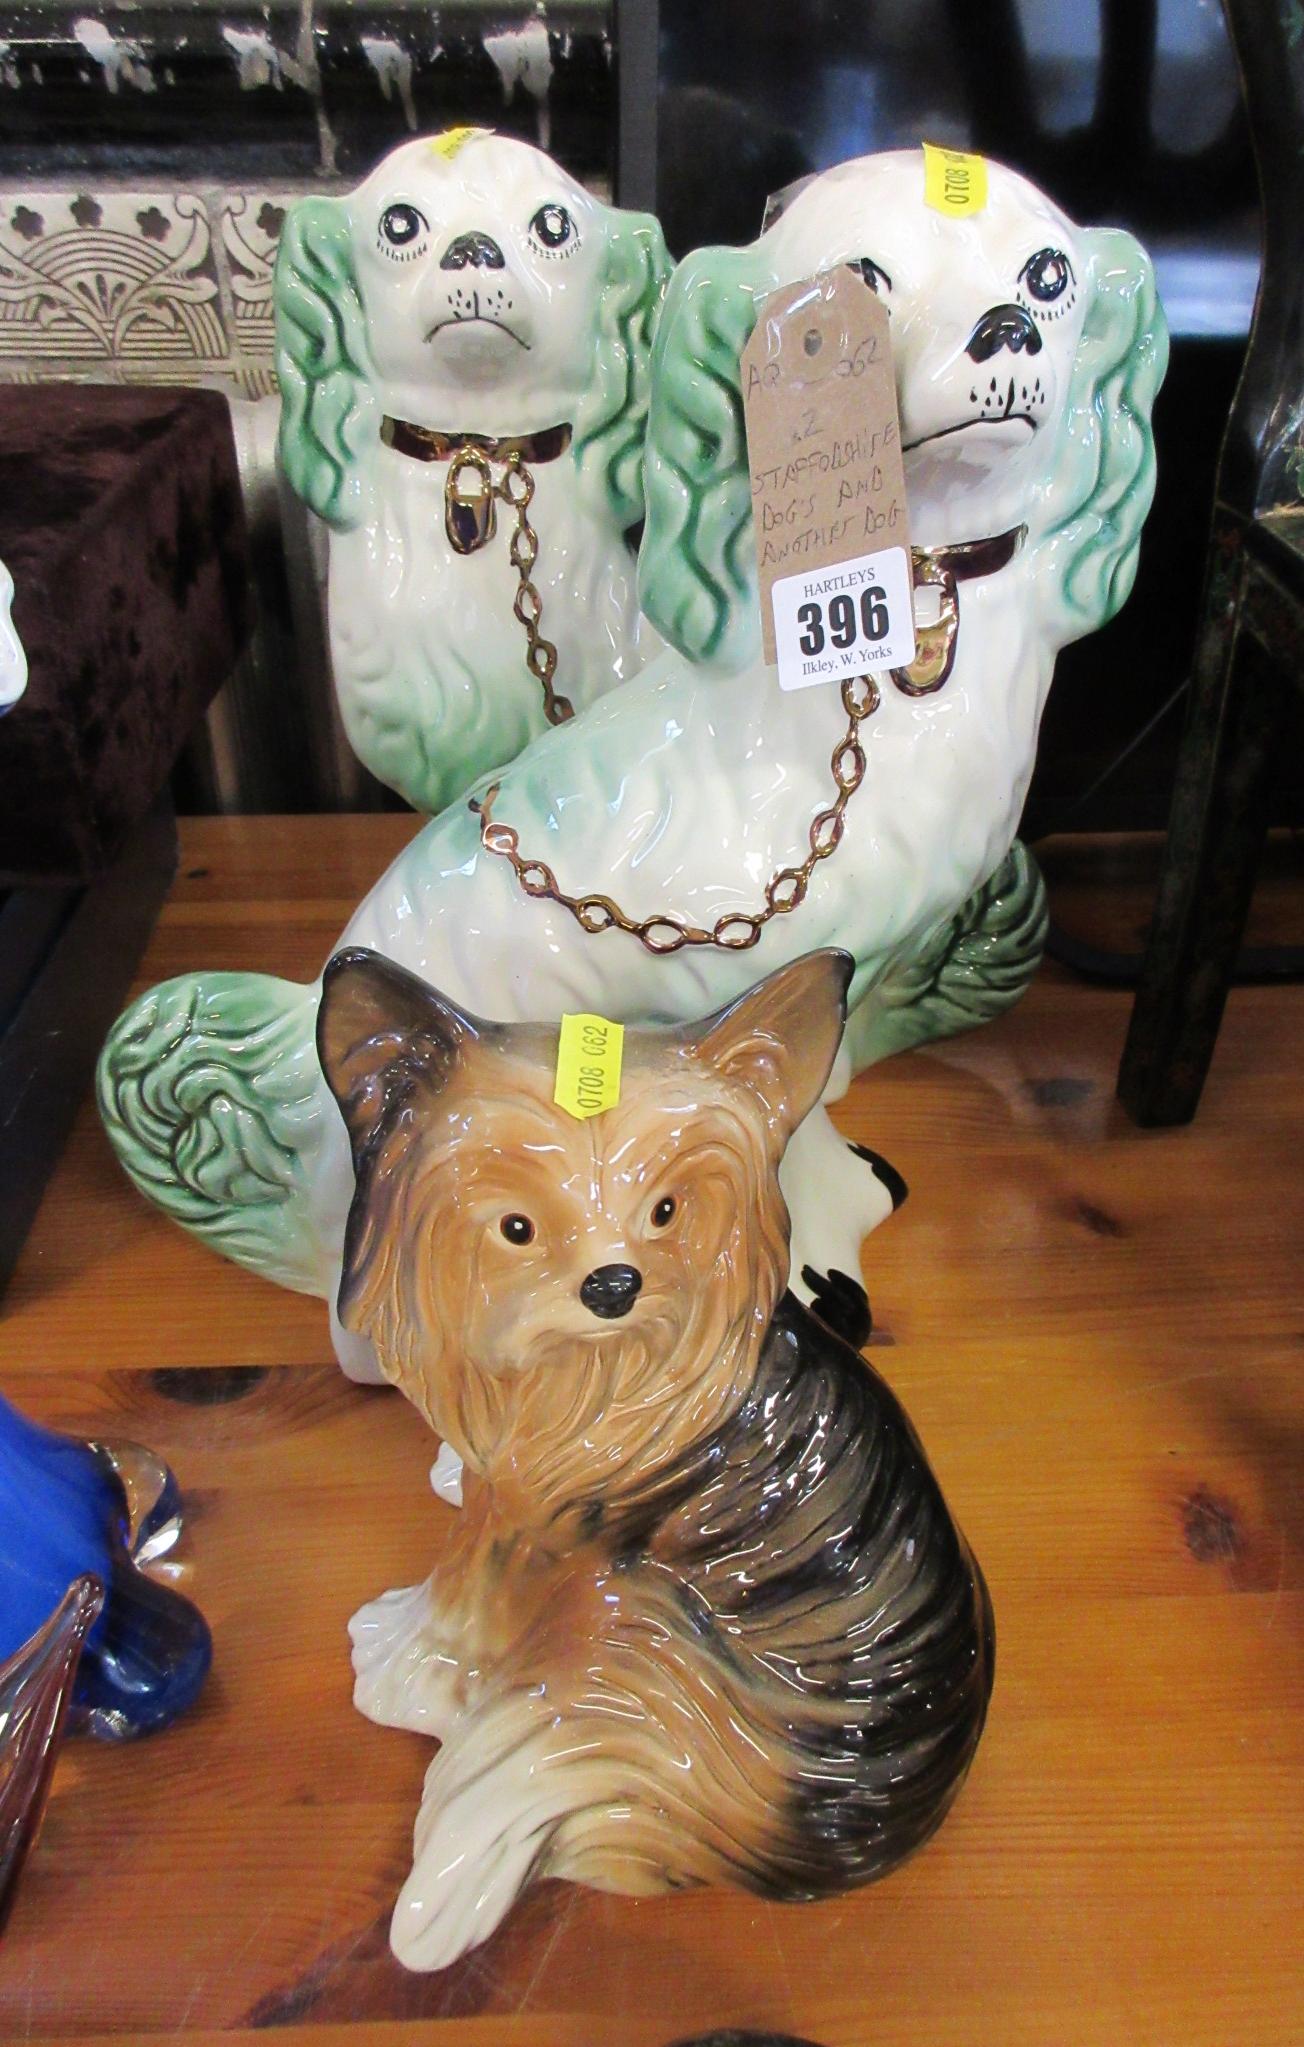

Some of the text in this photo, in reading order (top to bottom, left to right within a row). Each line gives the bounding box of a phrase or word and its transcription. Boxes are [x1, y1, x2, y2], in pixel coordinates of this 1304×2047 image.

[944, 168, 970, 204] 0708
[837, 465, 883, 508] AND
[864, 499, 905, 536] DOG
[804, 567, 876, 598] HARTLEYS
[797, 585, 890, 657] 396
[840, 654, 857, 667] W.
[858, 645, 893, 663] Yorks
[577, 1066, 604, 1108] 0708
